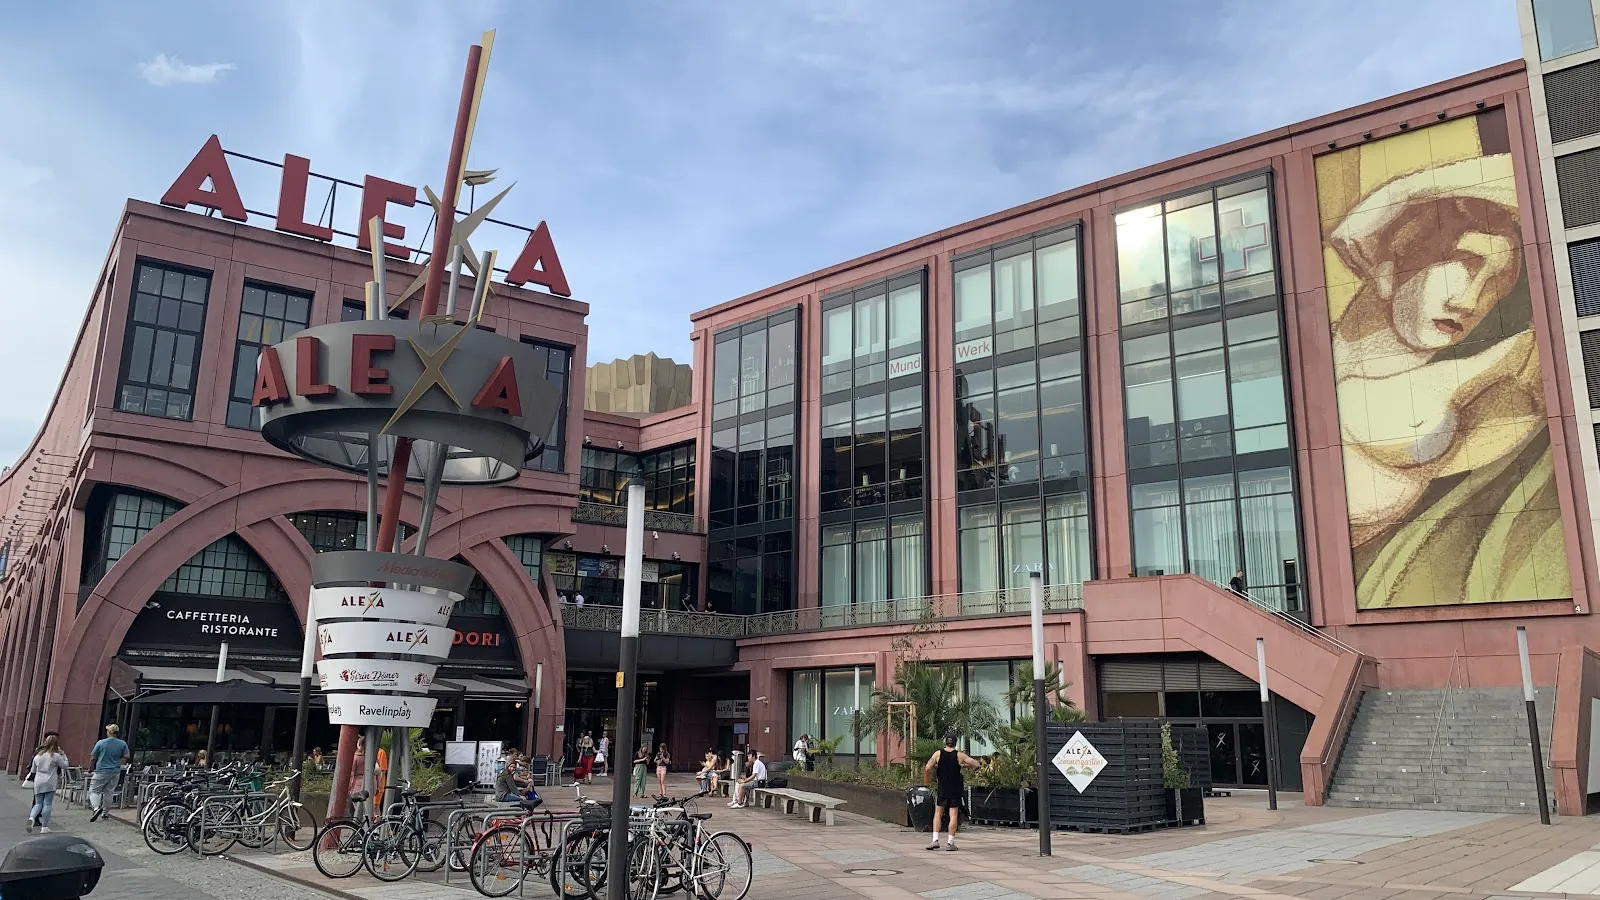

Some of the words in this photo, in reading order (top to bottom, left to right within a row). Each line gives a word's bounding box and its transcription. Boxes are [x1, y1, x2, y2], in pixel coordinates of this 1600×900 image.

[160, 134, 572, 308] ALEXA
[957, 341, 991, 358] Werk
[890, 357, 921, 375] Mund
[252, 316, 522, 437] ALEXA
[1013, 563, 1054, 573] ZARA
[341, 591, 385, 614] ALEXA
[166, 610, 250, 624] CAFFETTERIA
[201, 624, 278, 637] RISTORANTE
[386, 628, 428, 651] ALEXA
[359, 705, 411, 719] Ravelinplatz
[1066, 745, 1092, 759] ALEXA
